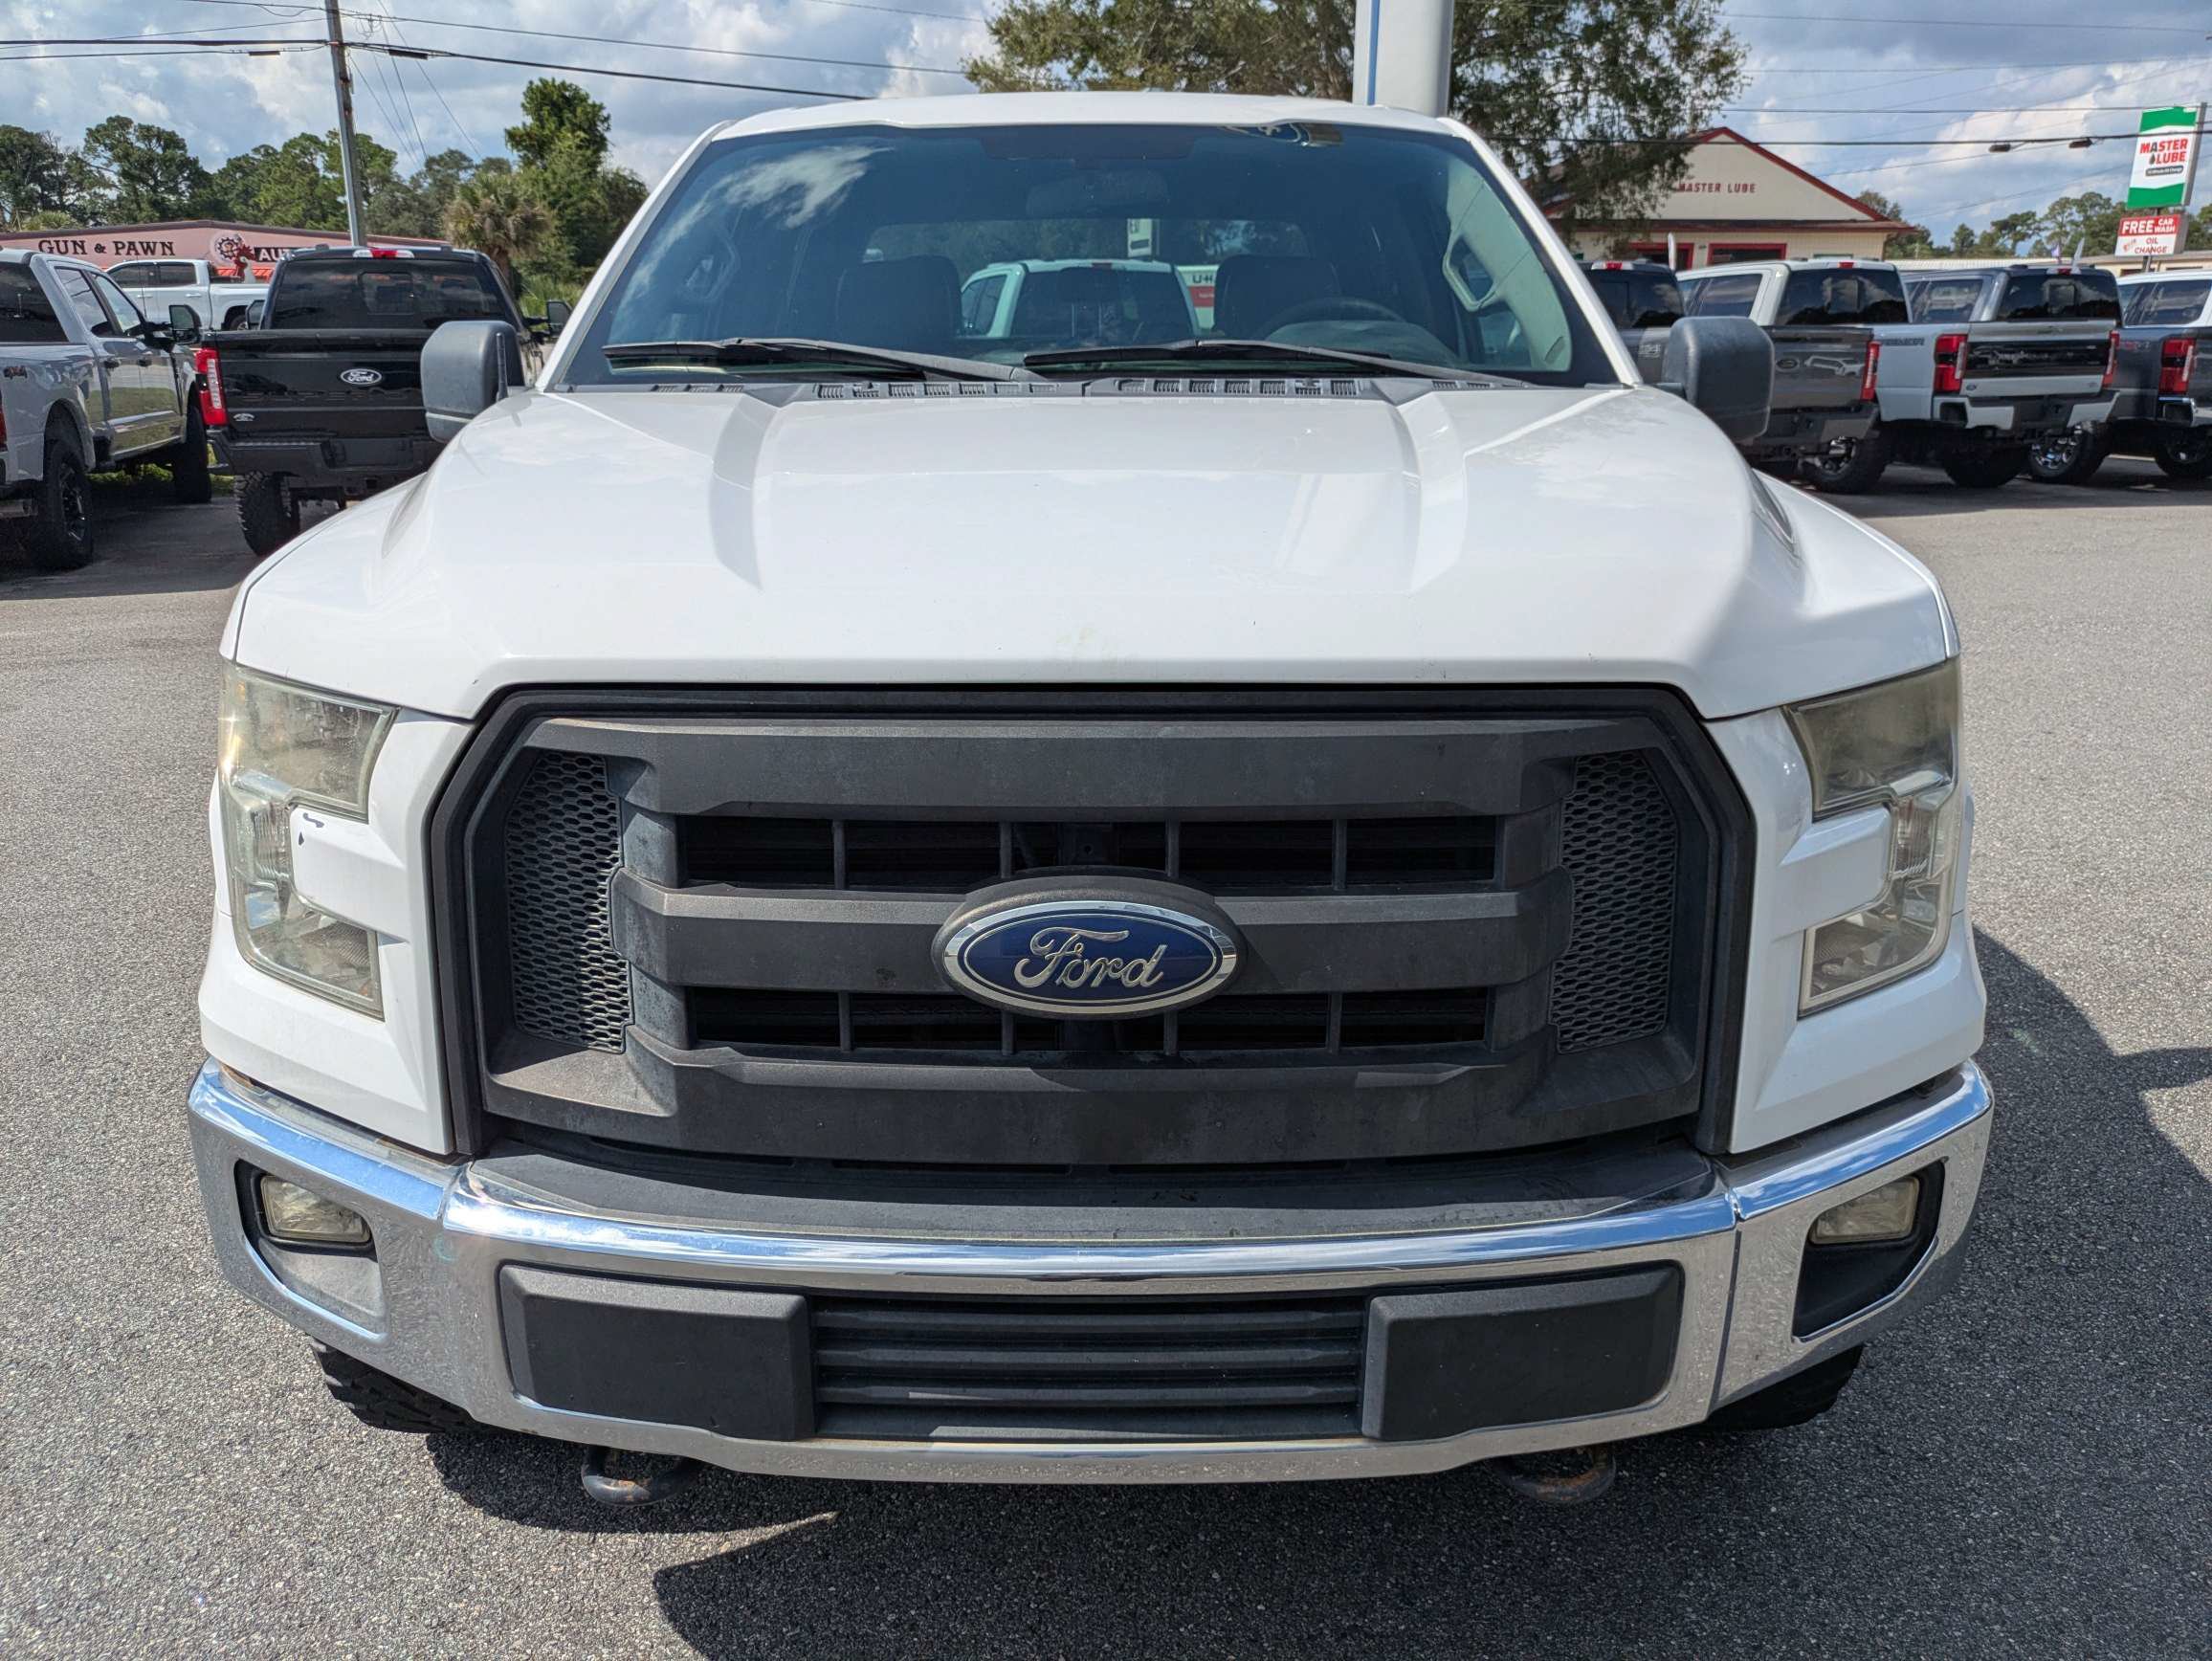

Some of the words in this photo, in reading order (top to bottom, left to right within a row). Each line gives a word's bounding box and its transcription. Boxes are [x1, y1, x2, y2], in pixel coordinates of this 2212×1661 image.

[2139, 138, 2188, 154] MASTER
[2156, 151, 2186, 165] LUBE
[1678, 182, 1721, 193] MASTER
[1728, 183, 1757, 193] LUBE
[2121, 219, 2156, 234] FREE
[2157, 217, 2175, 226] CAR
[2155, 225, 2176, 233] WASH
[2146, 236, 2158, 245] OIL
[38, 239, 88, 255] GUN
[94, 243, 107, 255] &
[112, 241, 176, 256] PAWN
[2135, 245, 2168, 255] CHANGE
[1013, 926, 1168, 988] Ford
